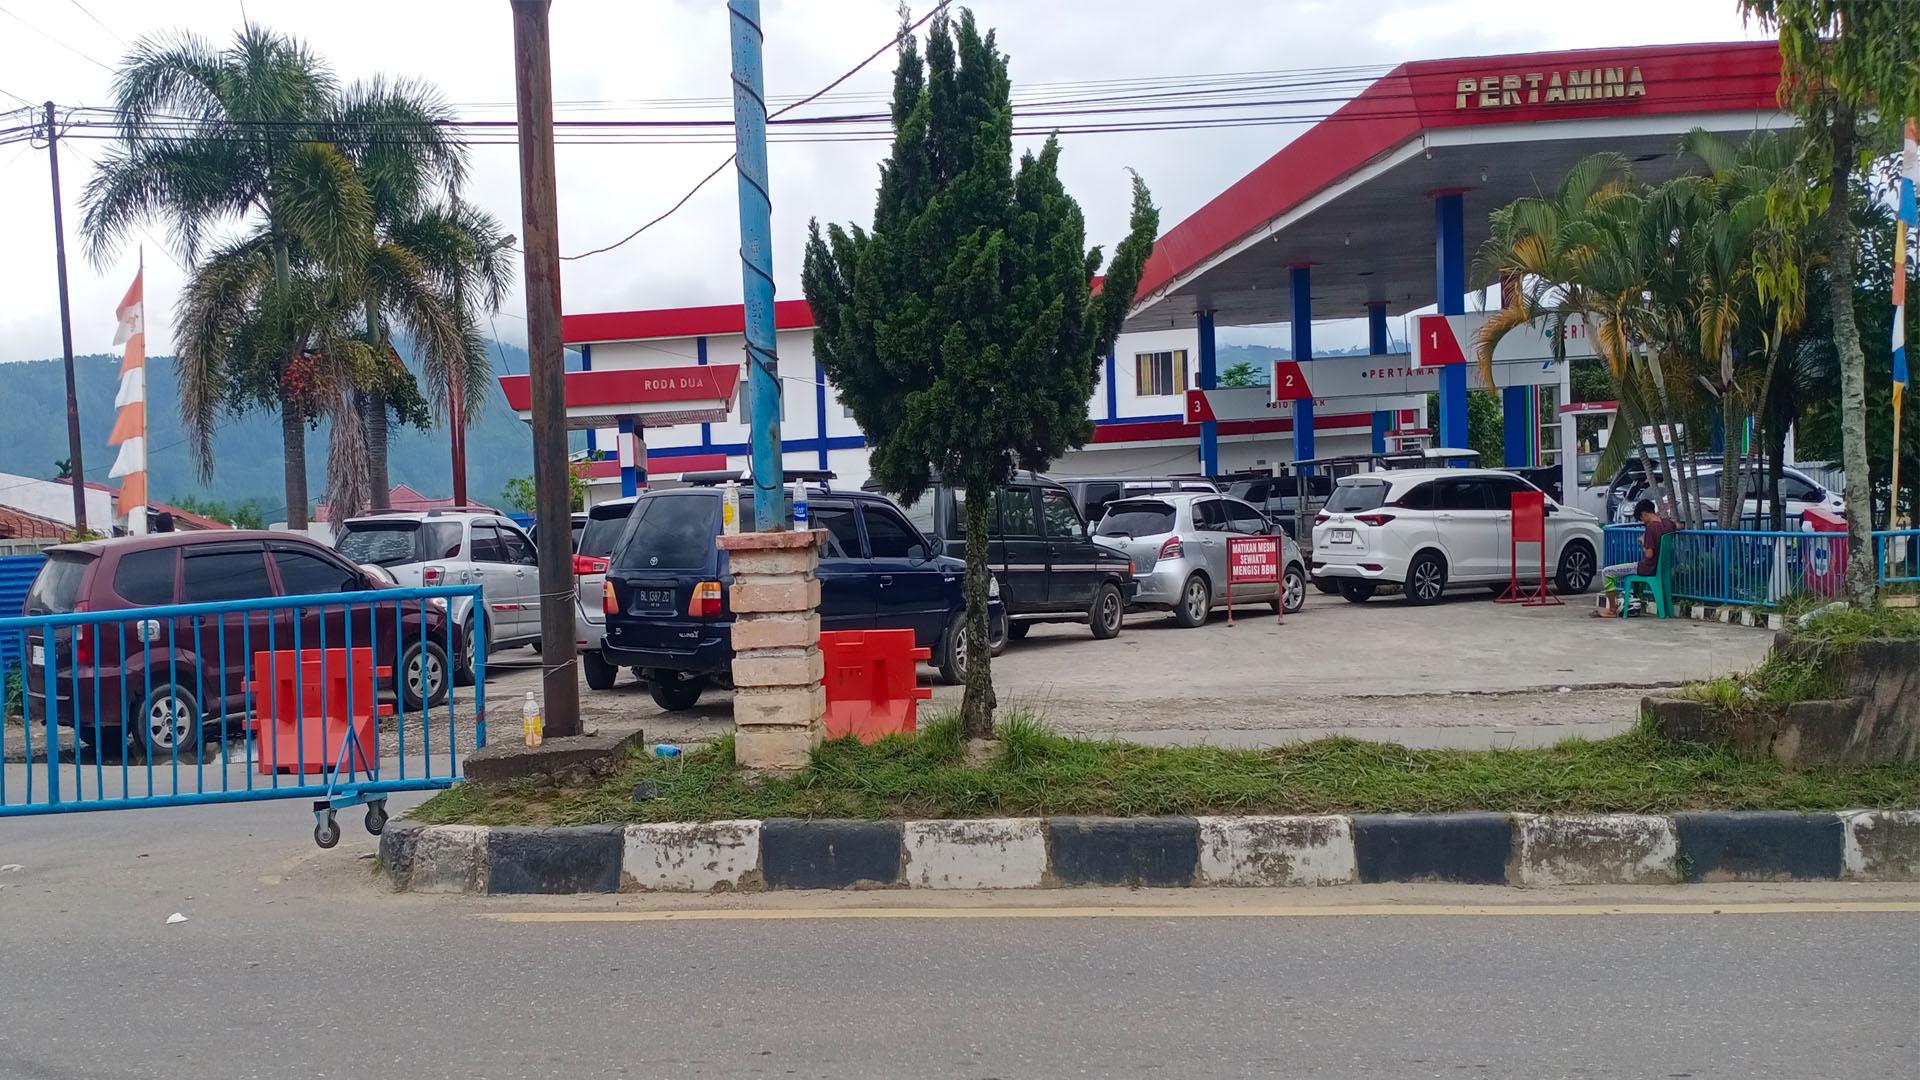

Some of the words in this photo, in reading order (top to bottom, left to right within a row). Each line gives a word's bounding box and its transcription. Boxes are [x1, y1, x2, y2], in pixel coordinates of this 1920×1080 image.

[1455, 66, 1646, 110] PERTAMINA
[1431, 331, 1438, 349] 1
[1369, 368, 1439, 378] PERTAMA
[644, 379, 676, 391] RODA
[680, 378, 704, 389] DUA
[1285, 375, 1294, 387] 2
[1194, 400, 1201, 413] 3
[1232, 543, 1257, 553] MATIKAN
[1258, 542, 1276, 552] MESIN
[1240, 554, 1267, 564] SEWAKTU
[1232, 565, 1260, 576] MENGISI
[1261, 564, 1276, 575] BBM
